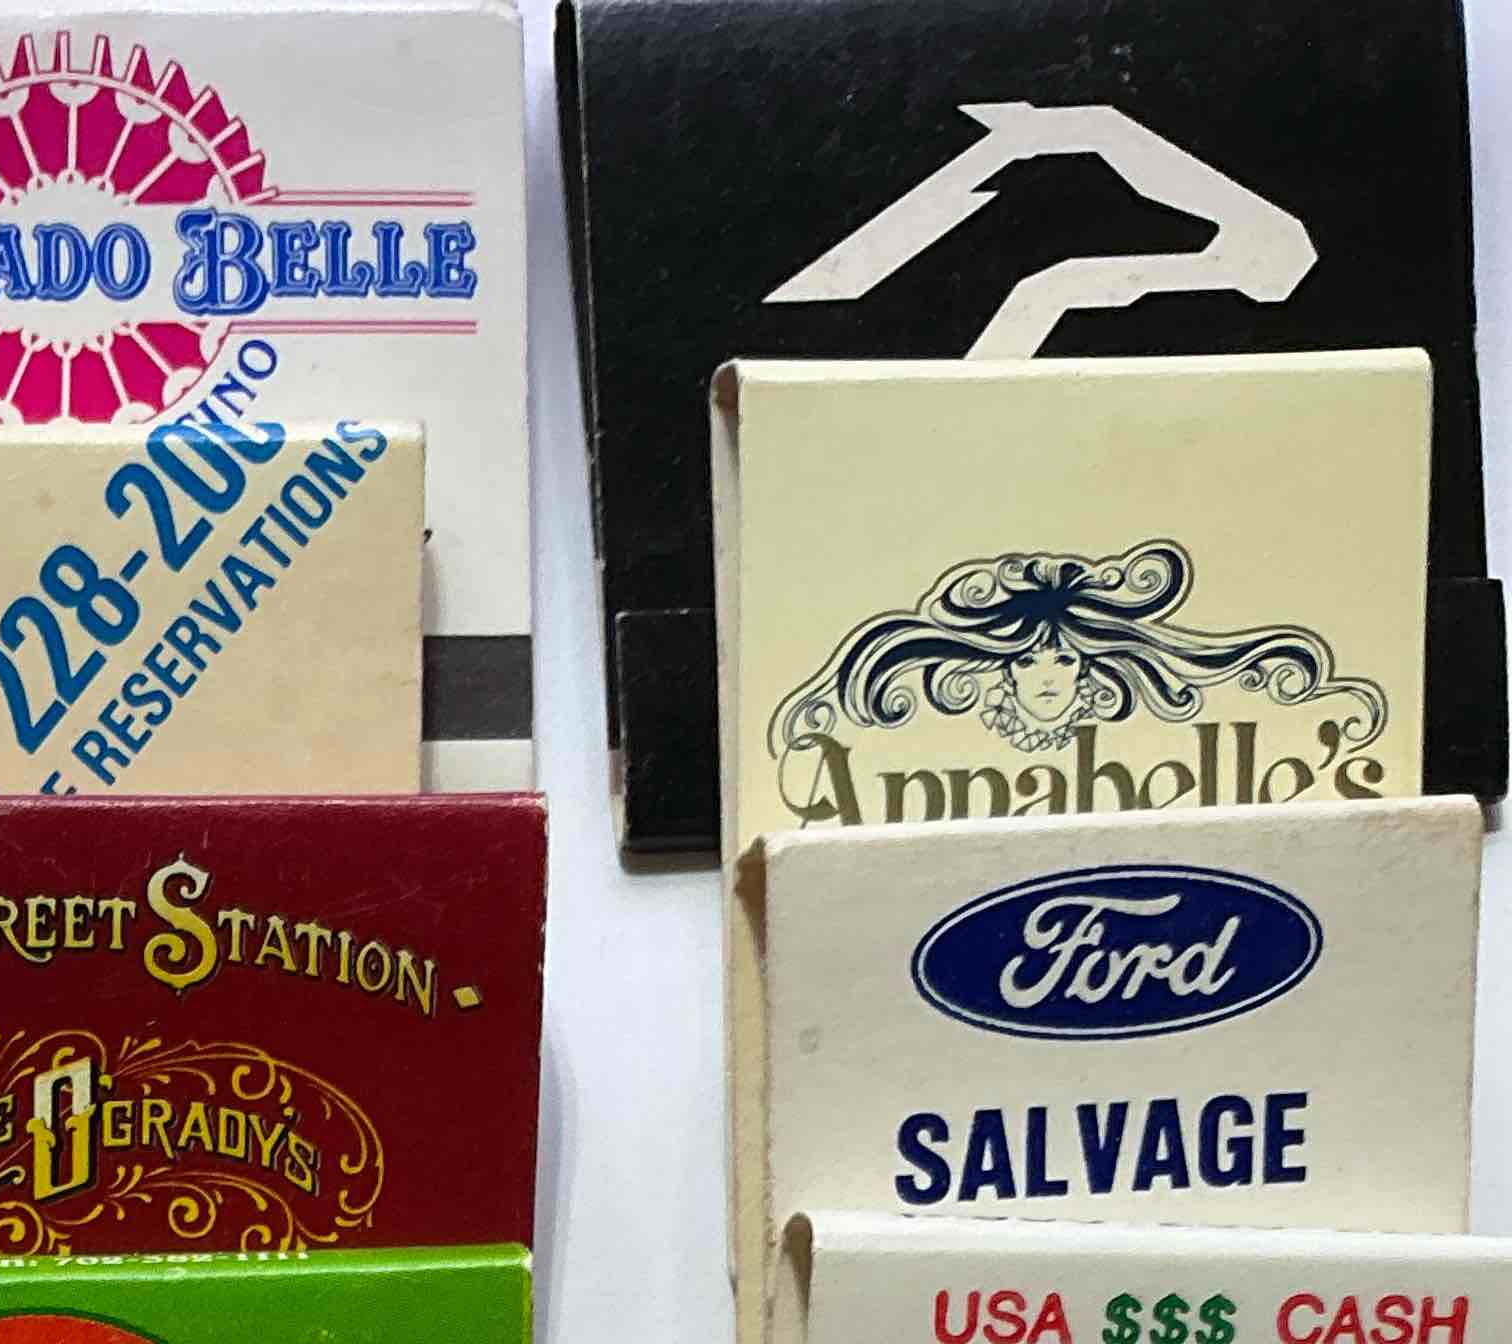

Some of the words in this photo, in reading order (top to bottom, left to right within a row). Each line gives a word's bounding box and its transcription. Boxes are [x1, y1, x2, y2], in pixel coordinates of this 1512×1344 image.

[173, 206, 480, 318] BELLE
[71, 420, 388, 787] RESERVATIONS
[146, 853, 440, 1016] STATION
[998, 891, 1248, 1010] Ford
[893, 1091, 1310, 1206] SALVAGE
